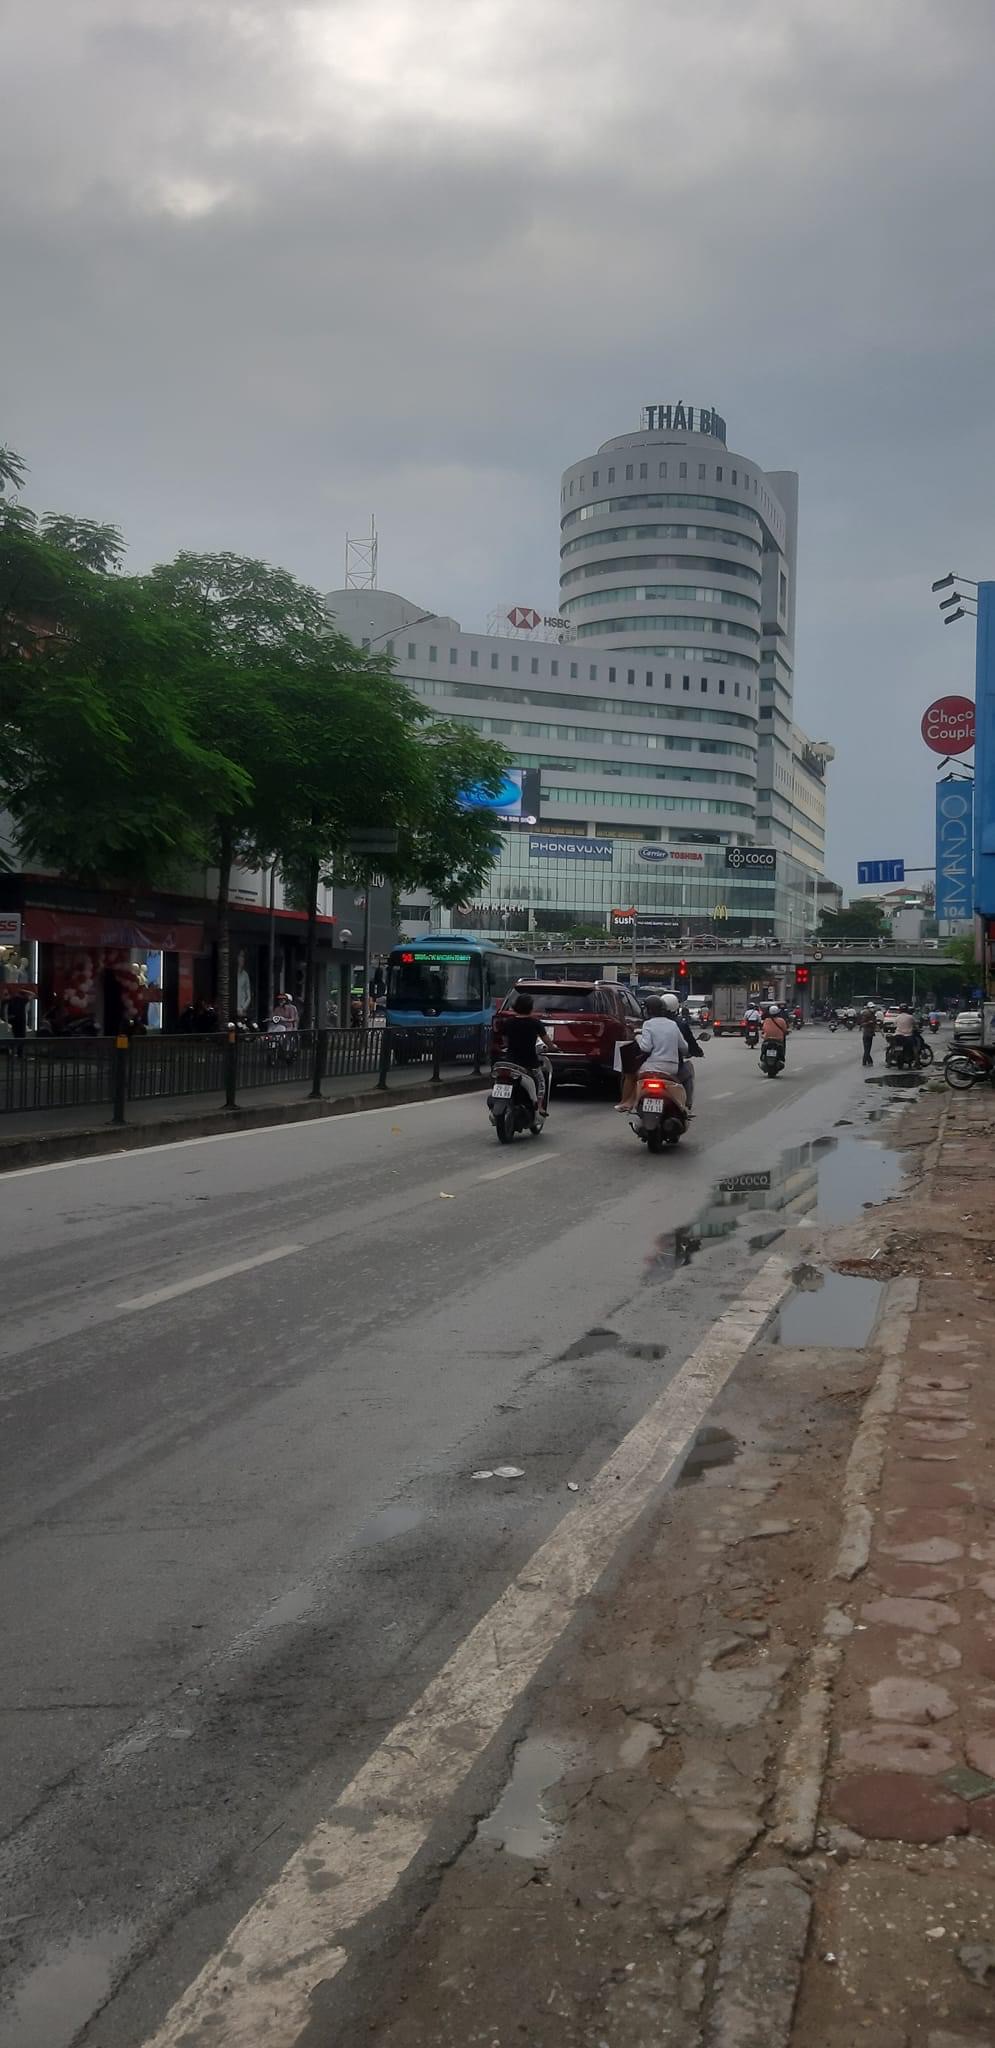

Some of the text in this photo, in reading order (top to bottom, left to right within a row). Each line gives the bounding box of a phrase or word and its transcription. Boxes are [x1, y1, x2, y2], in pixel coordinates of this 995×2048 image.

[645, 400, 694, 432] THÁI
[543, 616, 571, 629] HSBC
[928, 709, 974, 725] Choco
[927, 724, 976, 741] Couple
[530, 841, 612, 855] PHONGVU.VN
[642, 849, 667, 858] Carrier
[940, 794, 967, 903] MANDO
[669, 851, 703, 861] TOSHIBA
[942, 906, 966, 917] 104
[614, 915, 637, 926] sush
